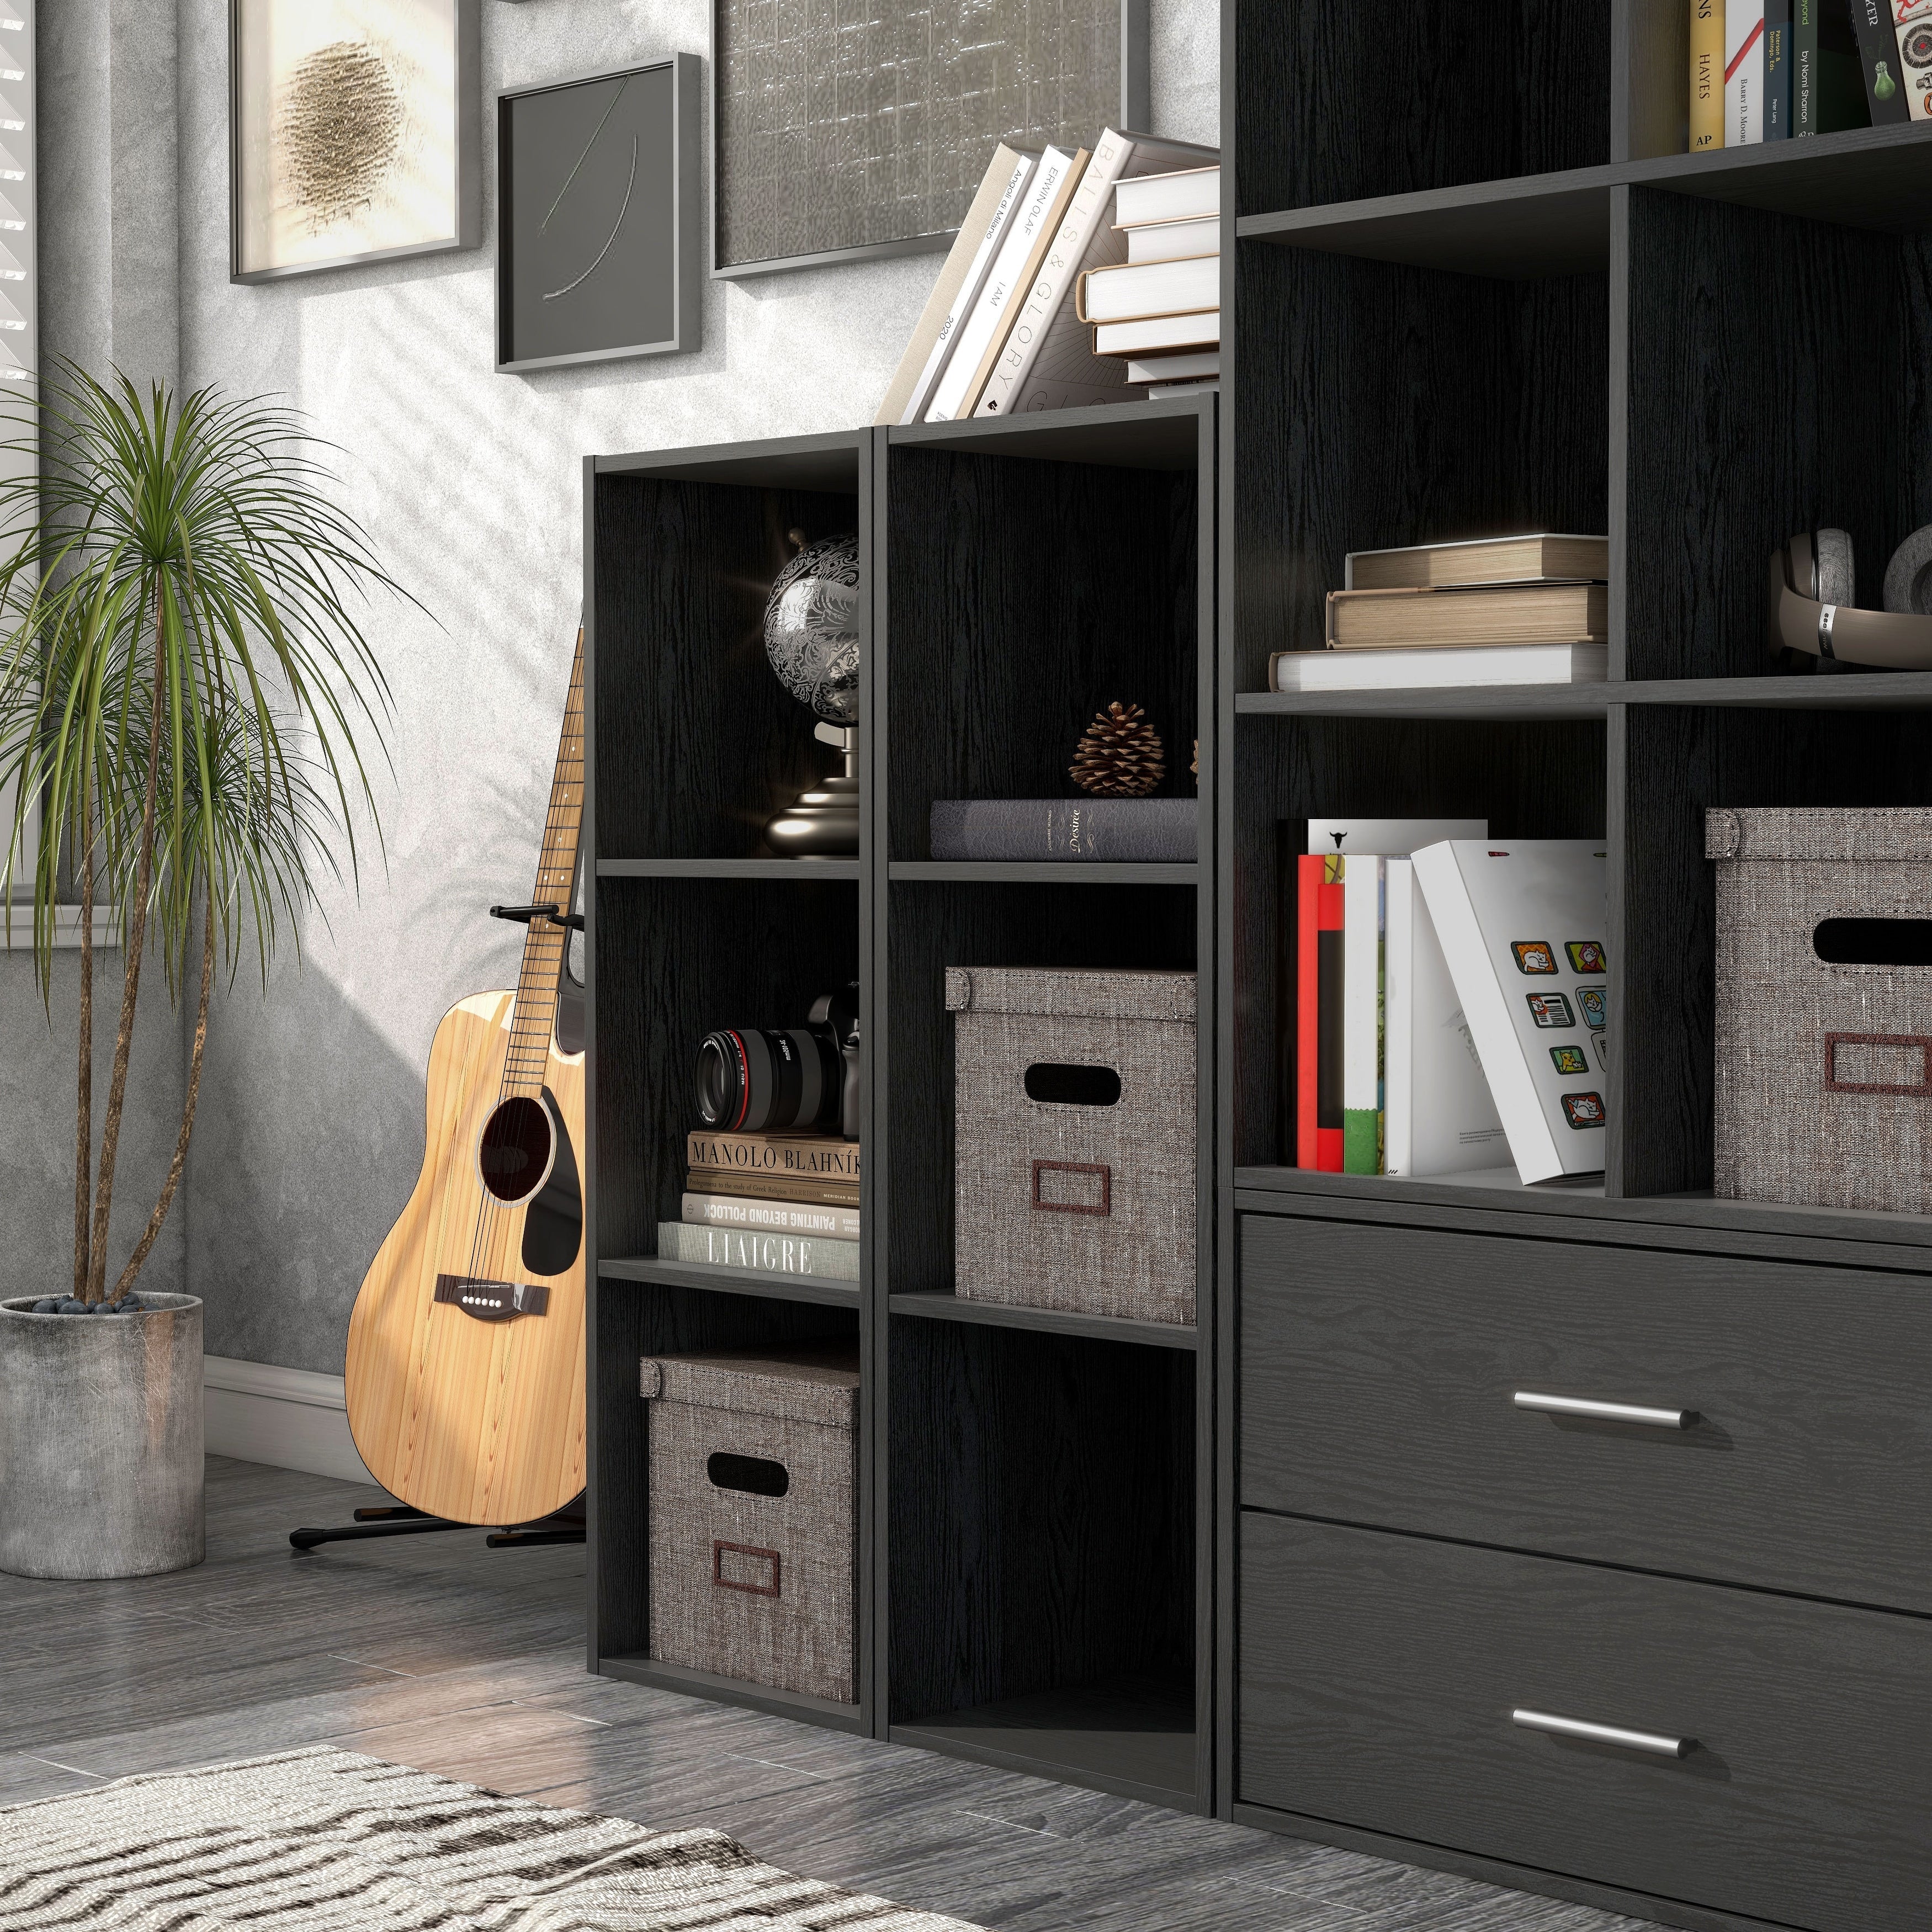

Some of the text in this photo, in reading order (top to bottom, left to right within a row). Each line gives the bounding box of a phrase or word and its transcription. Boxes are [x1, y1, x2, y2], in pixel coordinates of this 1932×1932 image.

[1800, 50, 1809, 62] by
[1699, 53, 1710, 99] HAYES
[1740, 105, 1748, 114] D.
[1696, 135, 1712, 146] AP
[986, 169, 1022, 239] Angoli di Milano
[1025, 167, 1058, 236] ERWIN OLAF
[999, 144, 1114, 390] BALLS & GLORY
[990, 286, 1003, 306] AM
[939, 315, 954, 340] 2020
[692, 1141, 860, 1174] MANOLO BLAHNÍK
[689, 1178, 717, 1188] Prolegomena
[733, 1183, 745, 1192] study
[768, 1187, 787, 1197] Religion
[789, 1188, 821, 1197] HARRISON
[704, 1204, 835, 1231] PAINTING BEYOND POLLOCK
[708, 1232, 811, 1273] LIAIGRE
